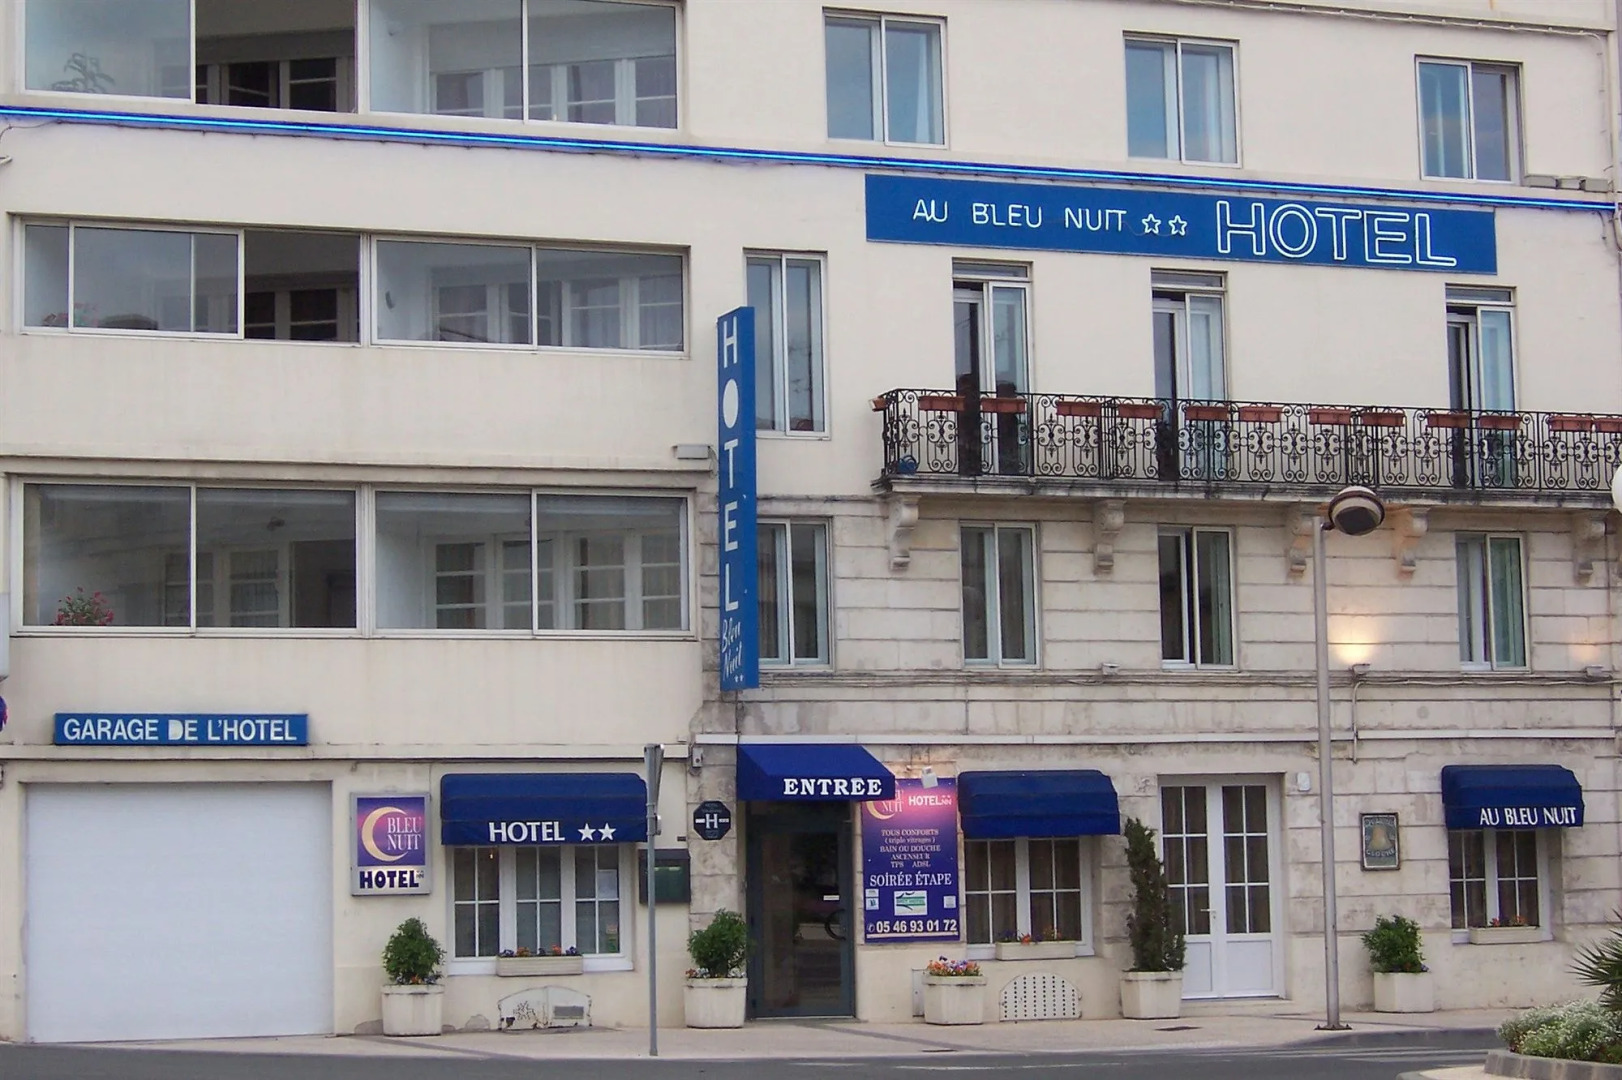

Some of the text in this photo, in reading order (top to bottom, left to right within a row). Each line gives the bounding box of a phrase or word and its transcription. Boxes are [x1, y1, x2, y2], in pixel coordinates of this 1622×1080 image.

[912, 198, 1457, 267] AU BLEU NUIT HOTEL
[722, 316, 740, 612] HOTEL
[63, 718, 298, 742] GARAGE DE L'HOTEL
[908, 795, 942, 806] HOTEL
[387, 816, 422, 833] BLEU
[705, 813, 719, 829] H
[1479, 807, 1577, 825] AU BLEU NUIT
[488, 821, 566, 843] HOTEL
[387, 834, 422, 850] NUIT
[880, 845, 898, 853] BAIN
[359, 870, 419, 889] HOTEL
[915, 871, 952, 886] ÉTAPE
[876, 919, 957, 933] 05 46 93 01 72
